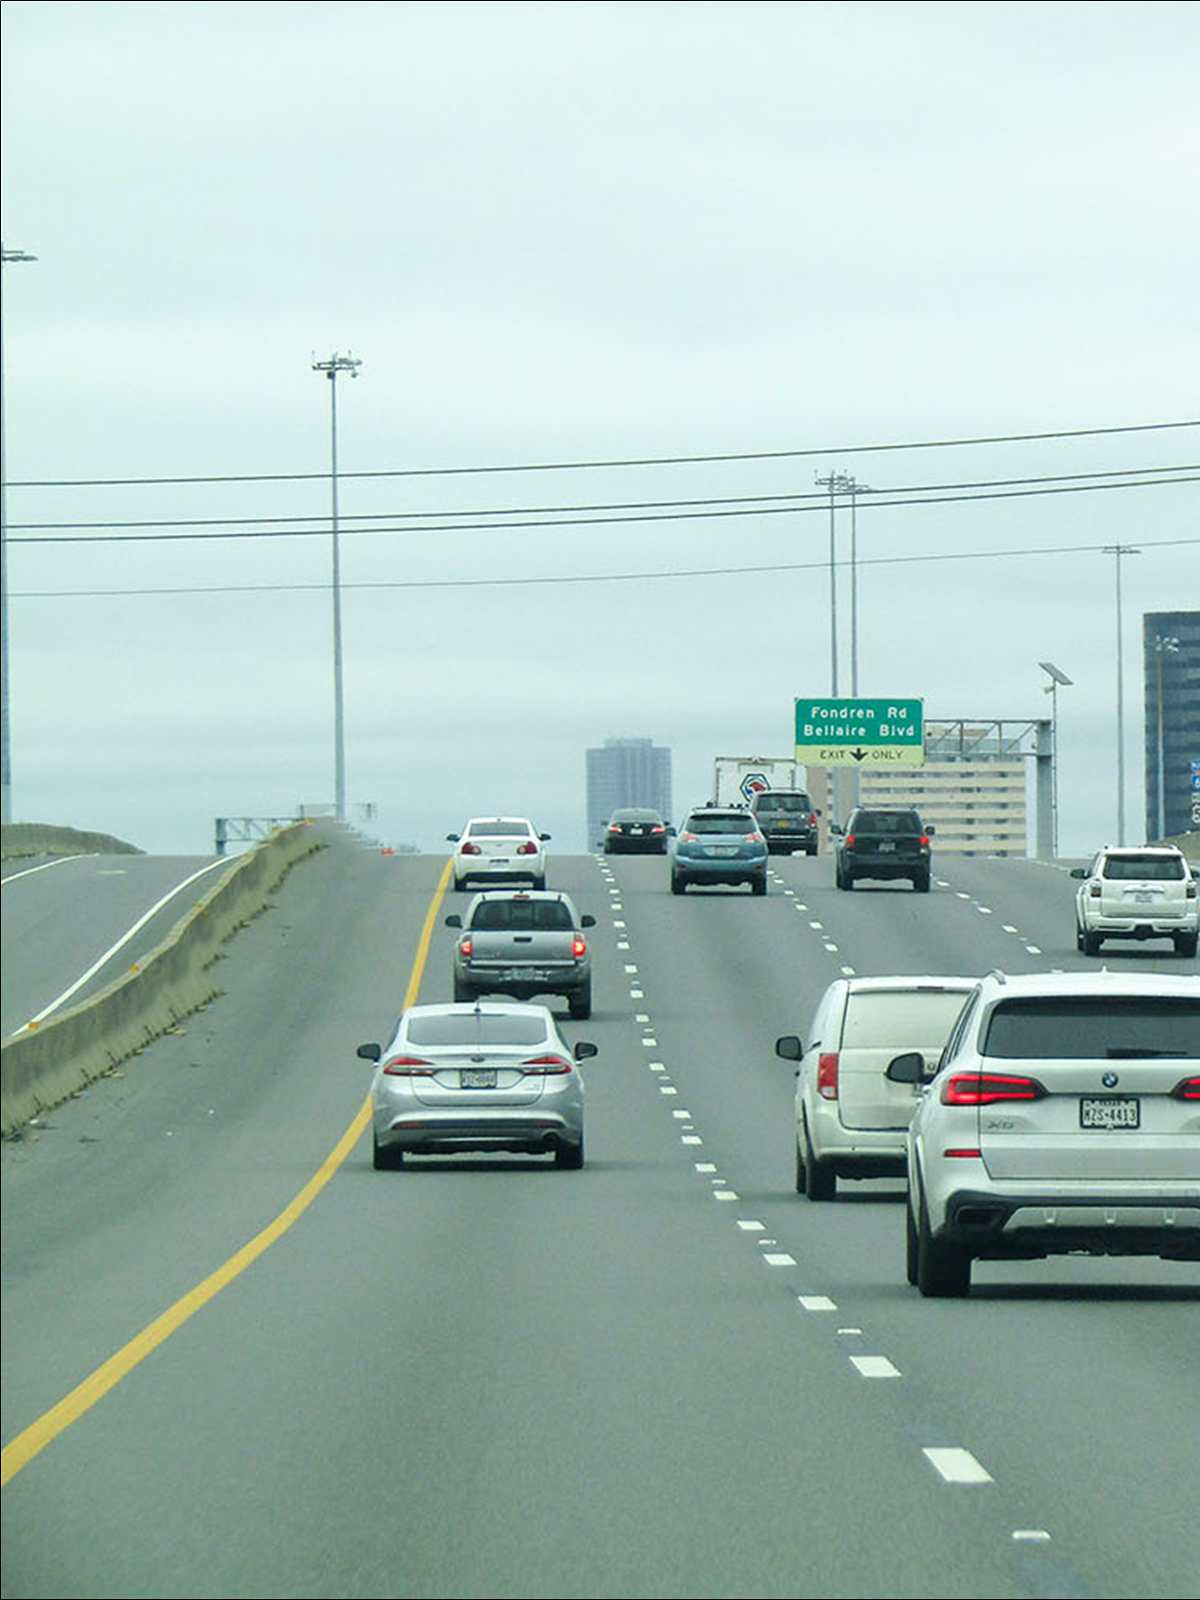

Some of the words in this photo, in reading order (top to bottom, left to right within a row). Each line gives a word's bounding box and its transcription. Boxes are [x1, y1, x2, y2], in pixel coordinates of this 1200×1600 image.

[811, 706, 875, 719] Fondren
[887, 706, 907, 719] Rd
[803, 724, 866, 736] Bellaire
[879, 724, 915, 736] Blvd
[820, 750, 845, 760] EXIT
[872, 750, 904, 760] ONLY
